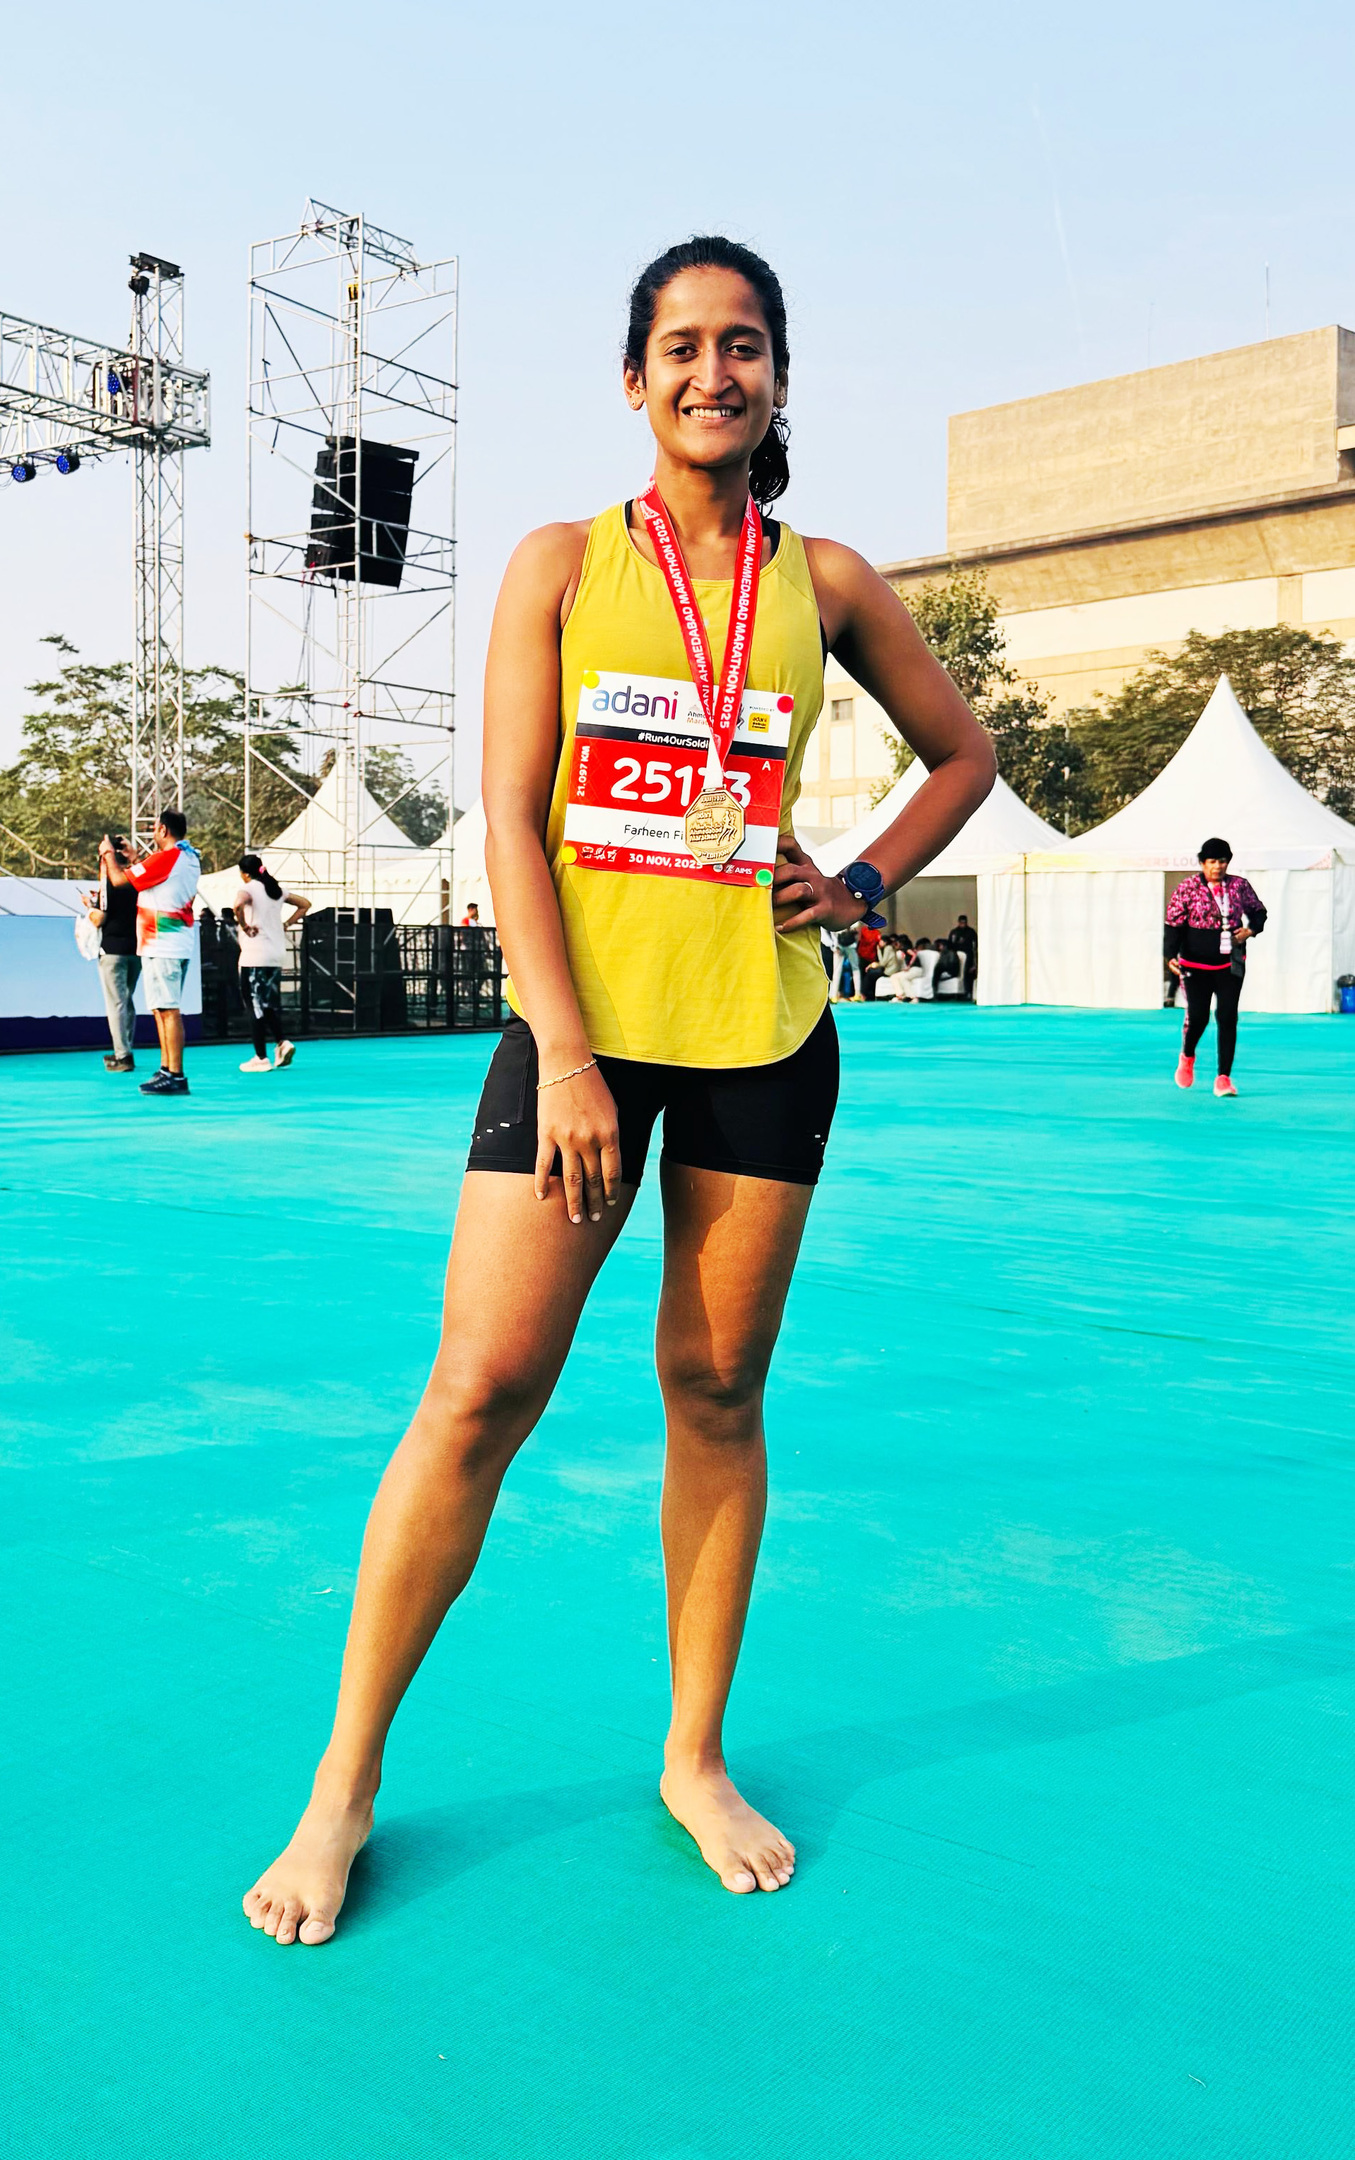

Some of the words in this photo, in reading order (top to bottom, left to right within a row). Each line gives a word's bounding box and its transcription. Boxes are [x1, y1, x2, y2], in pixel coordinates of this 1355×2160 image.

[652, 518, 671, 544] 2025
[744, 524, 756, 554] ADANI
[662, 544, 690, 605] MARATHON
[736, 554, 754, 620] AHMEDABAD
[682, 606, 709, 683] AHMEDABAD
[725, 622, 747, 694] MARATHON
[592, 685, 679, 720] adani
[720, 696, 735, 729] 2025
[580, 745, 591, 762] KM
[762, 760, 771, 771] A
[576, 763, 588, 797] 21.097
[623, 824, 670, 840] Farheen
[628, 852, 643, 863] 30
[646, 855, 673, 868] NOV,
[734, 867, 753, 875] AIMS
[1173, 857, 1198, 867] LOU
